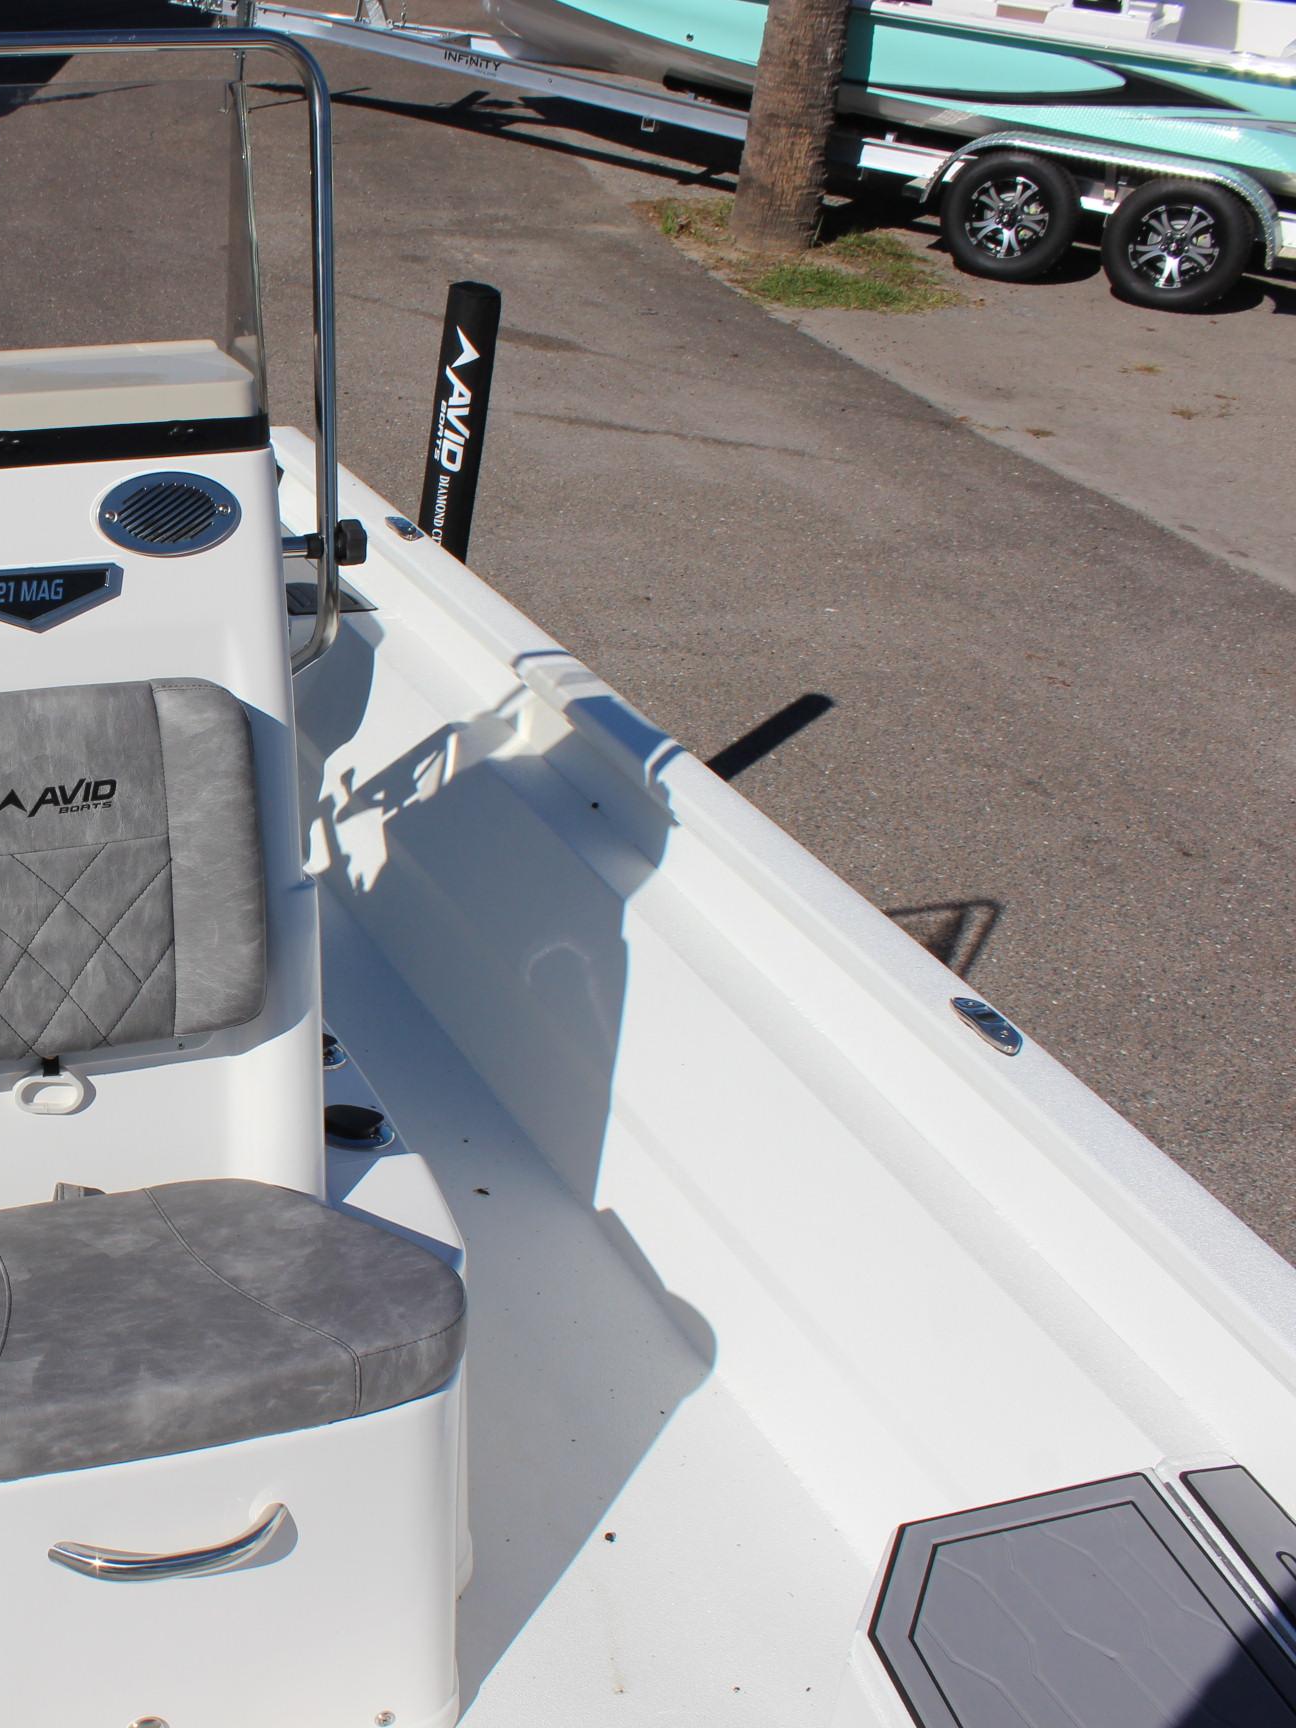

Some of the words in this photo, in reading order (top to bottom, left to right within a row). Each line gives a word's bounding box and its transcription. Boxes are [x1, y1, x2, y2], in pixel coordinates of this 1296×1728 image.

[433, 399, 447, 462] BOATS
[441, 365, 472, 472] AVID
[433, 475, 450, 528] DIAMOND
[20, 579, 64, 602] MAG
[27, 777, 117, 818] AVID
[58, 800, 112, 814] BOATS
